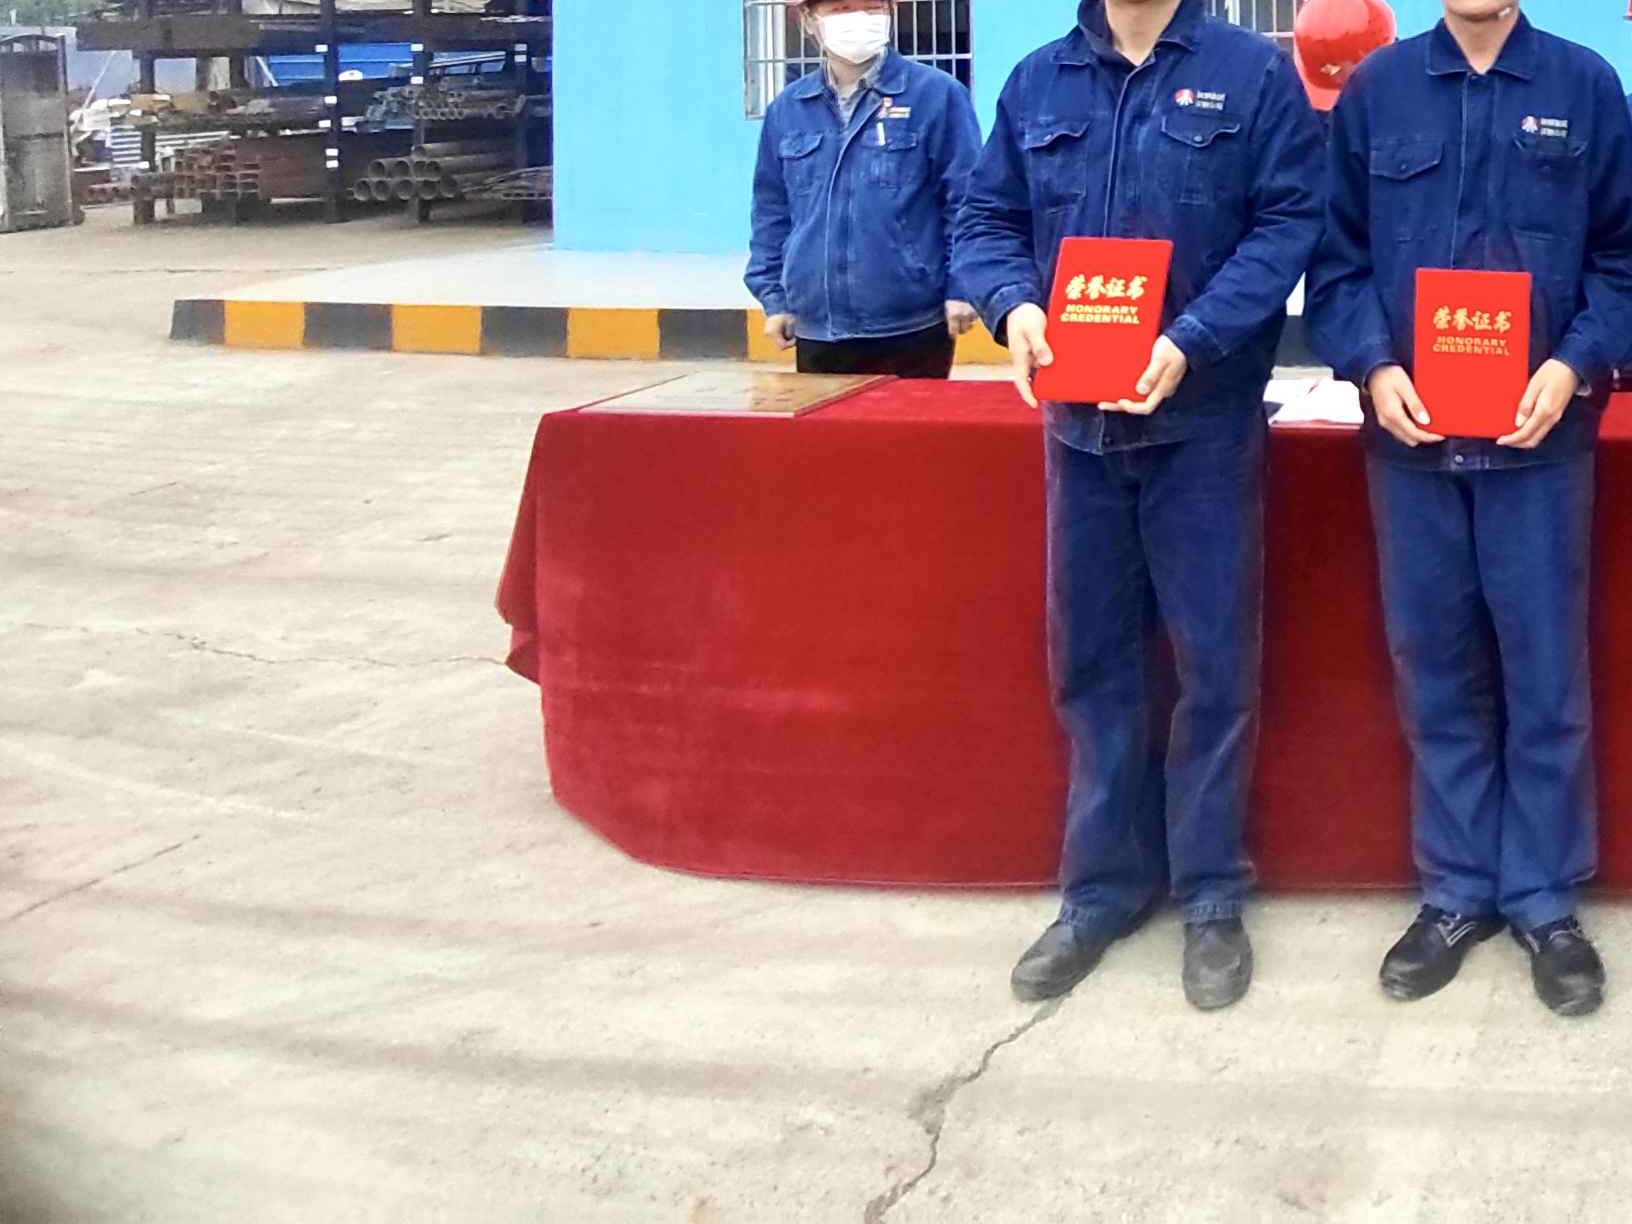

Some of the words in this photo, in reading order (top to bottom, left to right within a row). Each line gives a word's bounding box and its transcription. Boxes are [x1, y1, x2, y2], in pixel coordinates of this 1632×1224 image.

[1065, 274, 1147, 300] 荣誉证书
[1066, 304, 1138, 314] HONORARY
[1060, 313, 1140, 324] CREDENTIAL
[1432, 305, 1512, 334] 荣誉证书
[1437, 336, 1507, 347] HONORARY
[1432, 344, 1510, 356] CREDENTIAL
